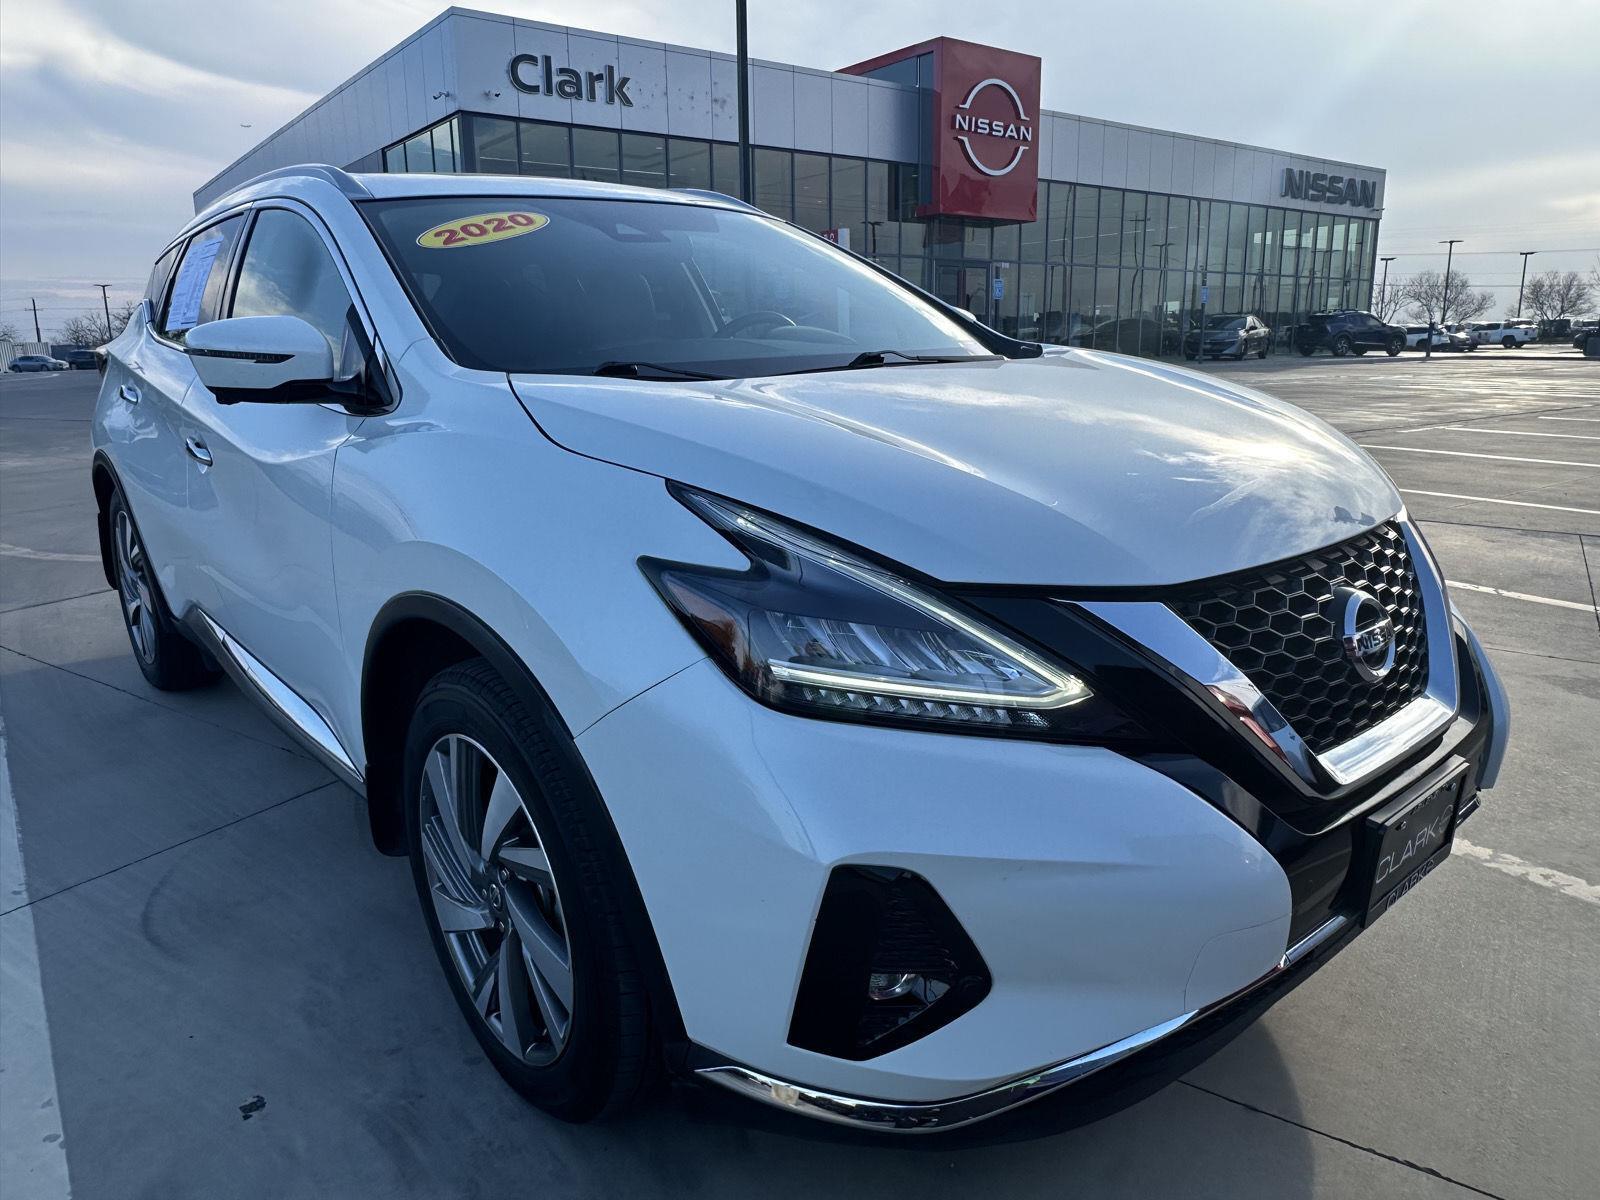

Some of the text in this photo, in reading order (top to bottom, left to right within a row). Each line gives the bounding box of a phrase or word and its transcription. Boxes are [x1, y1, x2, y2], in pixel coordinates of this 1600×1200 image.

[509, 53, 634, 107] Clark
[955, 113, 1032, 142] NISSAN
[1281, 167, 1377, 209] NISSAN
[434, 213, 535, 246] 2020
[1376, 817, 1440, 884] CLARK
